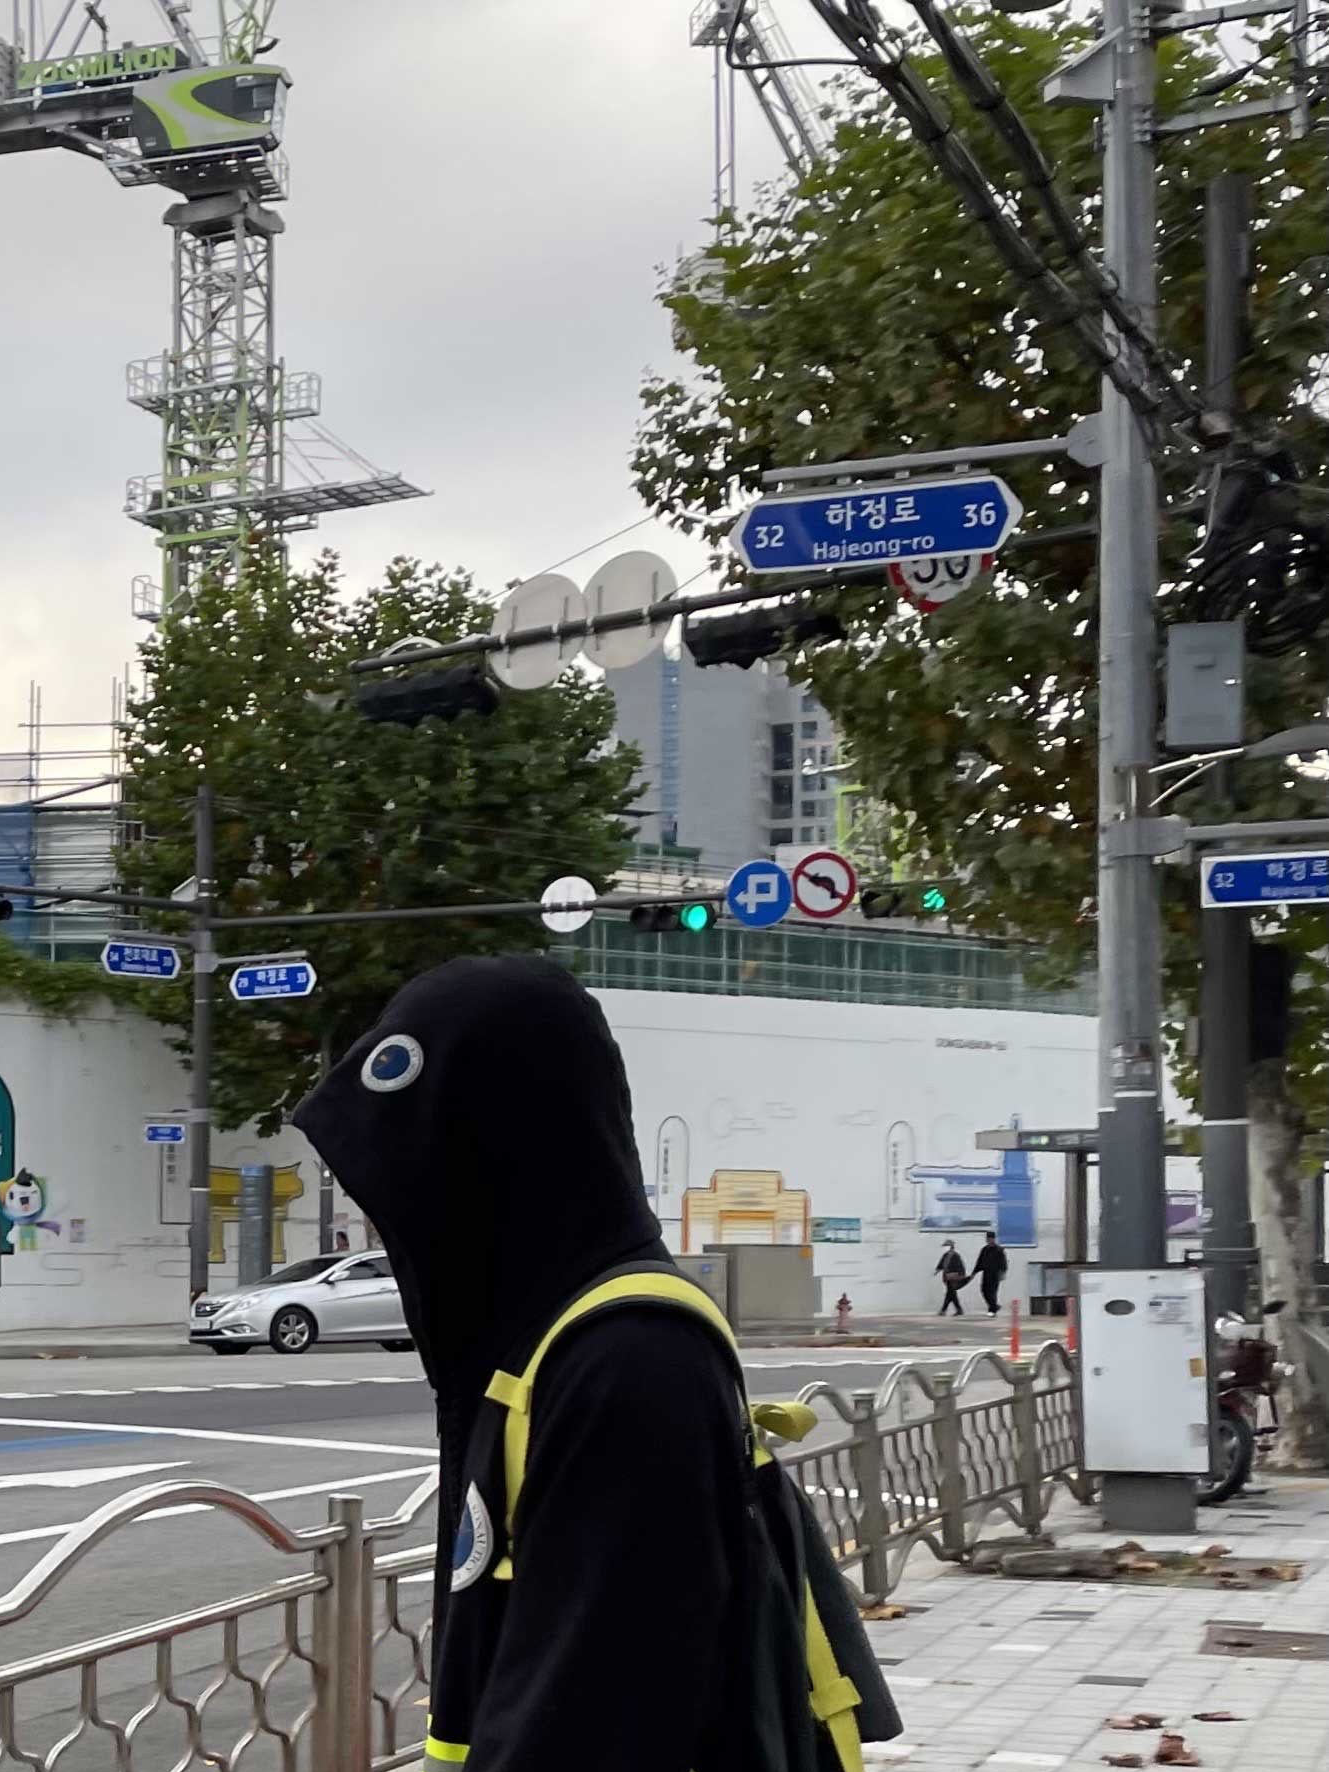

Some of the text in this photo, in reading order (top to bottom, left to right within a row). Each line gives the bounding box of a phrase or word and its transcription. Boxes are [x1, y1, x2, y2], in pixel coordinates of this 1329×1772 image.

[20, 44, 175, 84] ZOOMLION
[754, 495, 997, 549] 32 하정로 36
[813, 534, 935, 561] Hajeong-ro
[1213, 872, 1235, 889] 32
